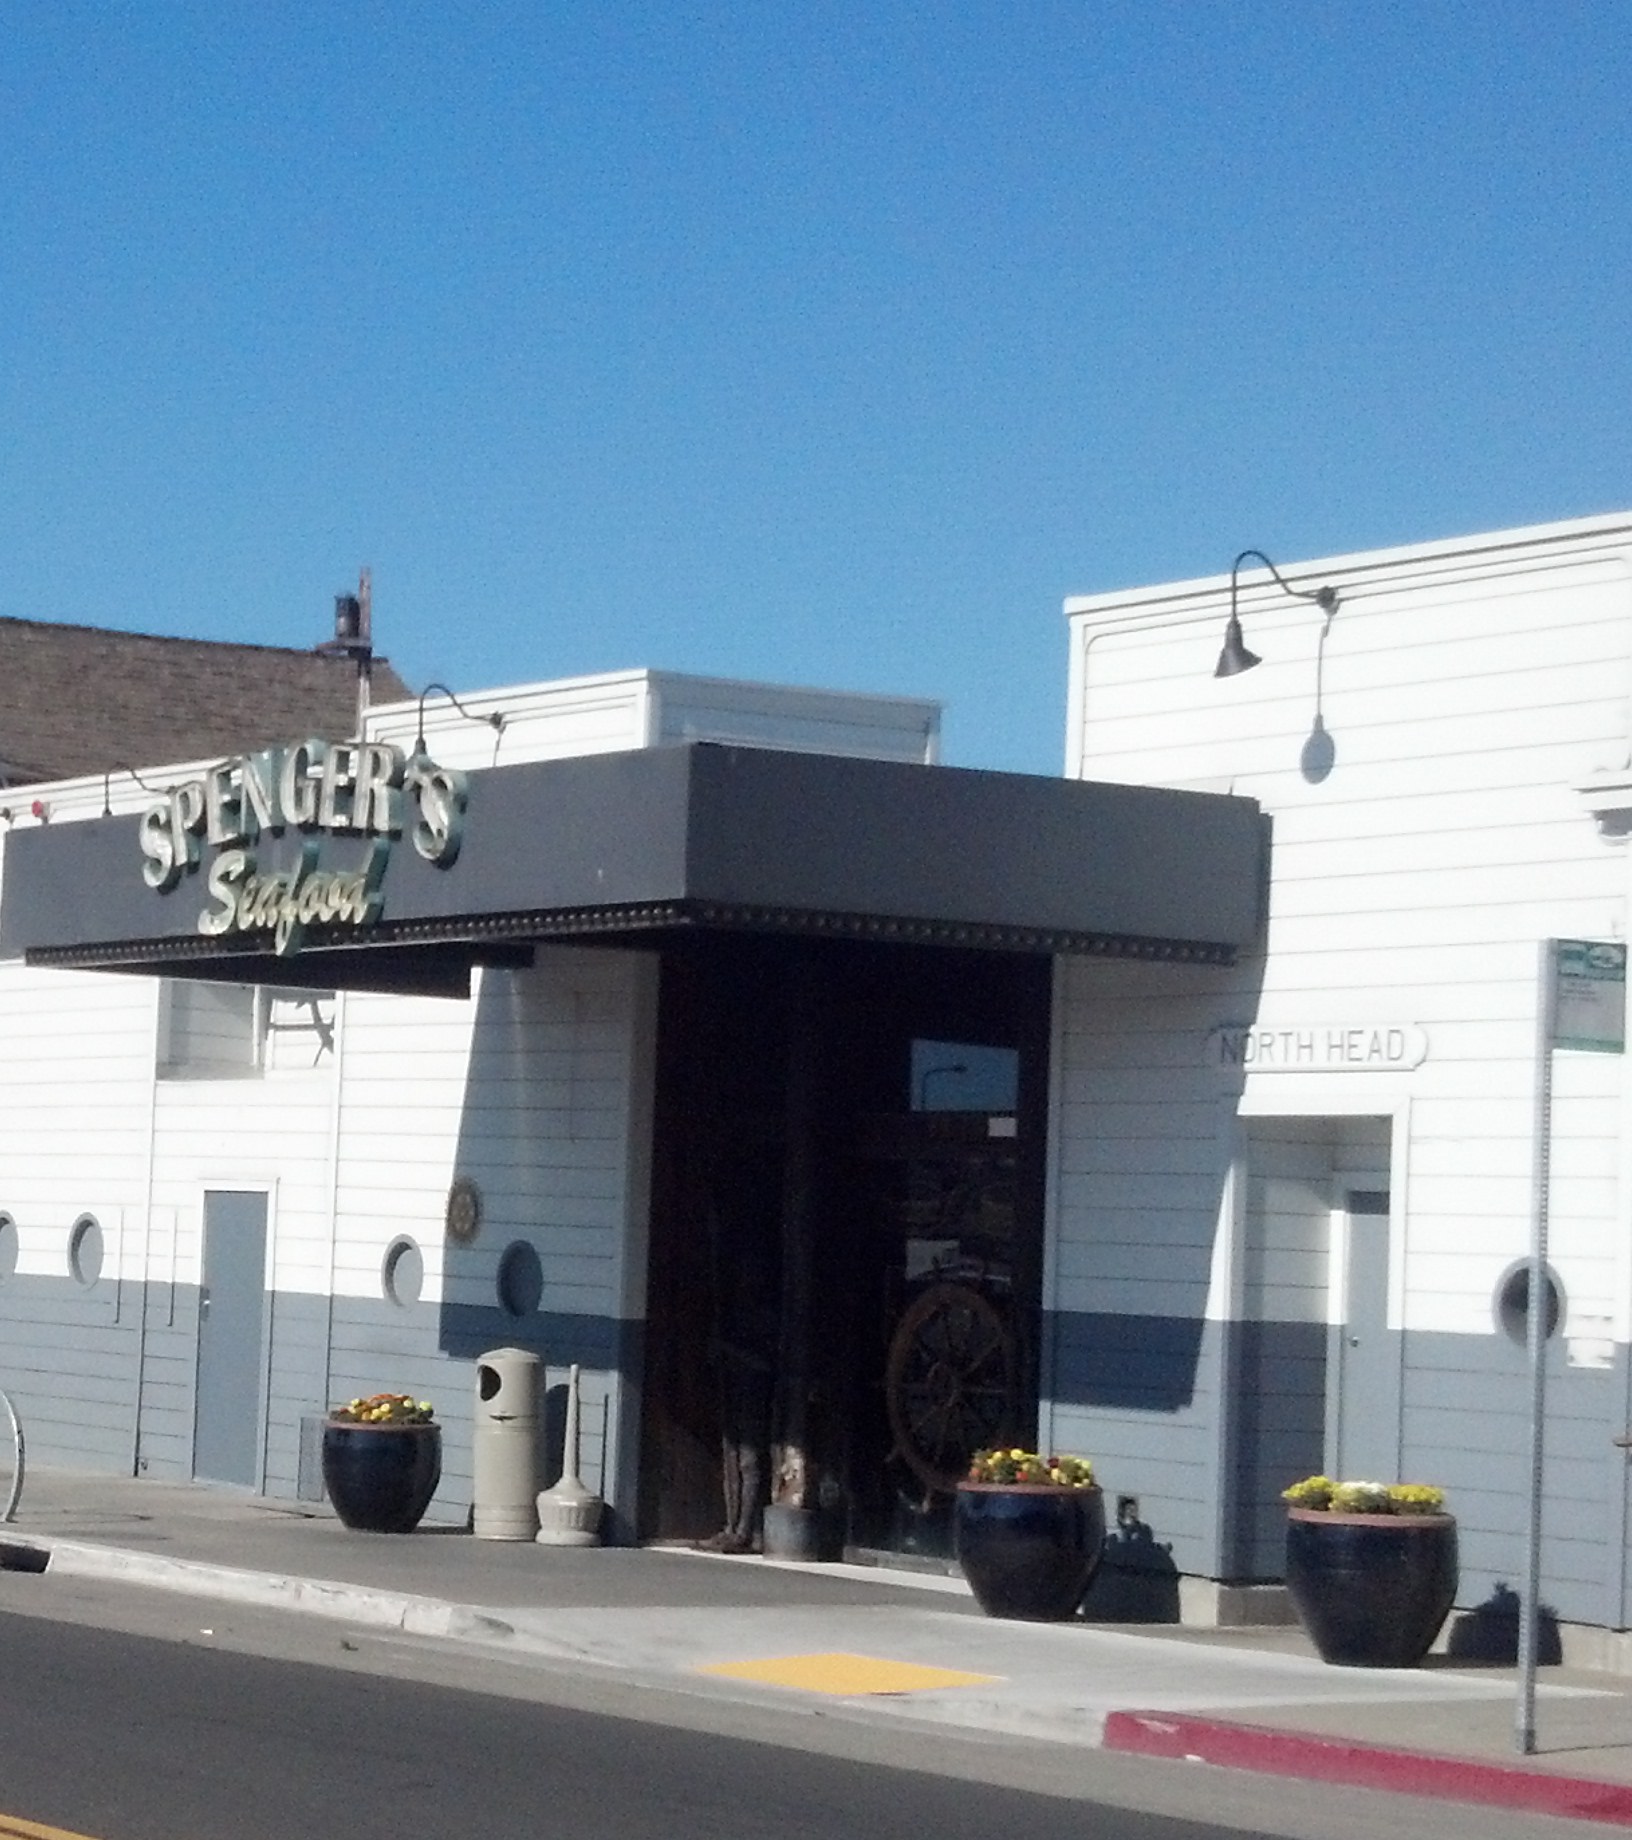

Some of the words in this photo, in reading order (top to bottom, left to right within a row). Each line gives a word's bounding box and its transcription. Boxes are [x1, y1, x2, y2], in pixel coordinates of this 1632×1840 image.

[139, 738, 468, 890] SPENGER'S
[198, 837, 388, 957] Seafood
[1219, 1029, 1313, 1064] NORTH
[1325, 1028, 1406, 1063] HEAD
